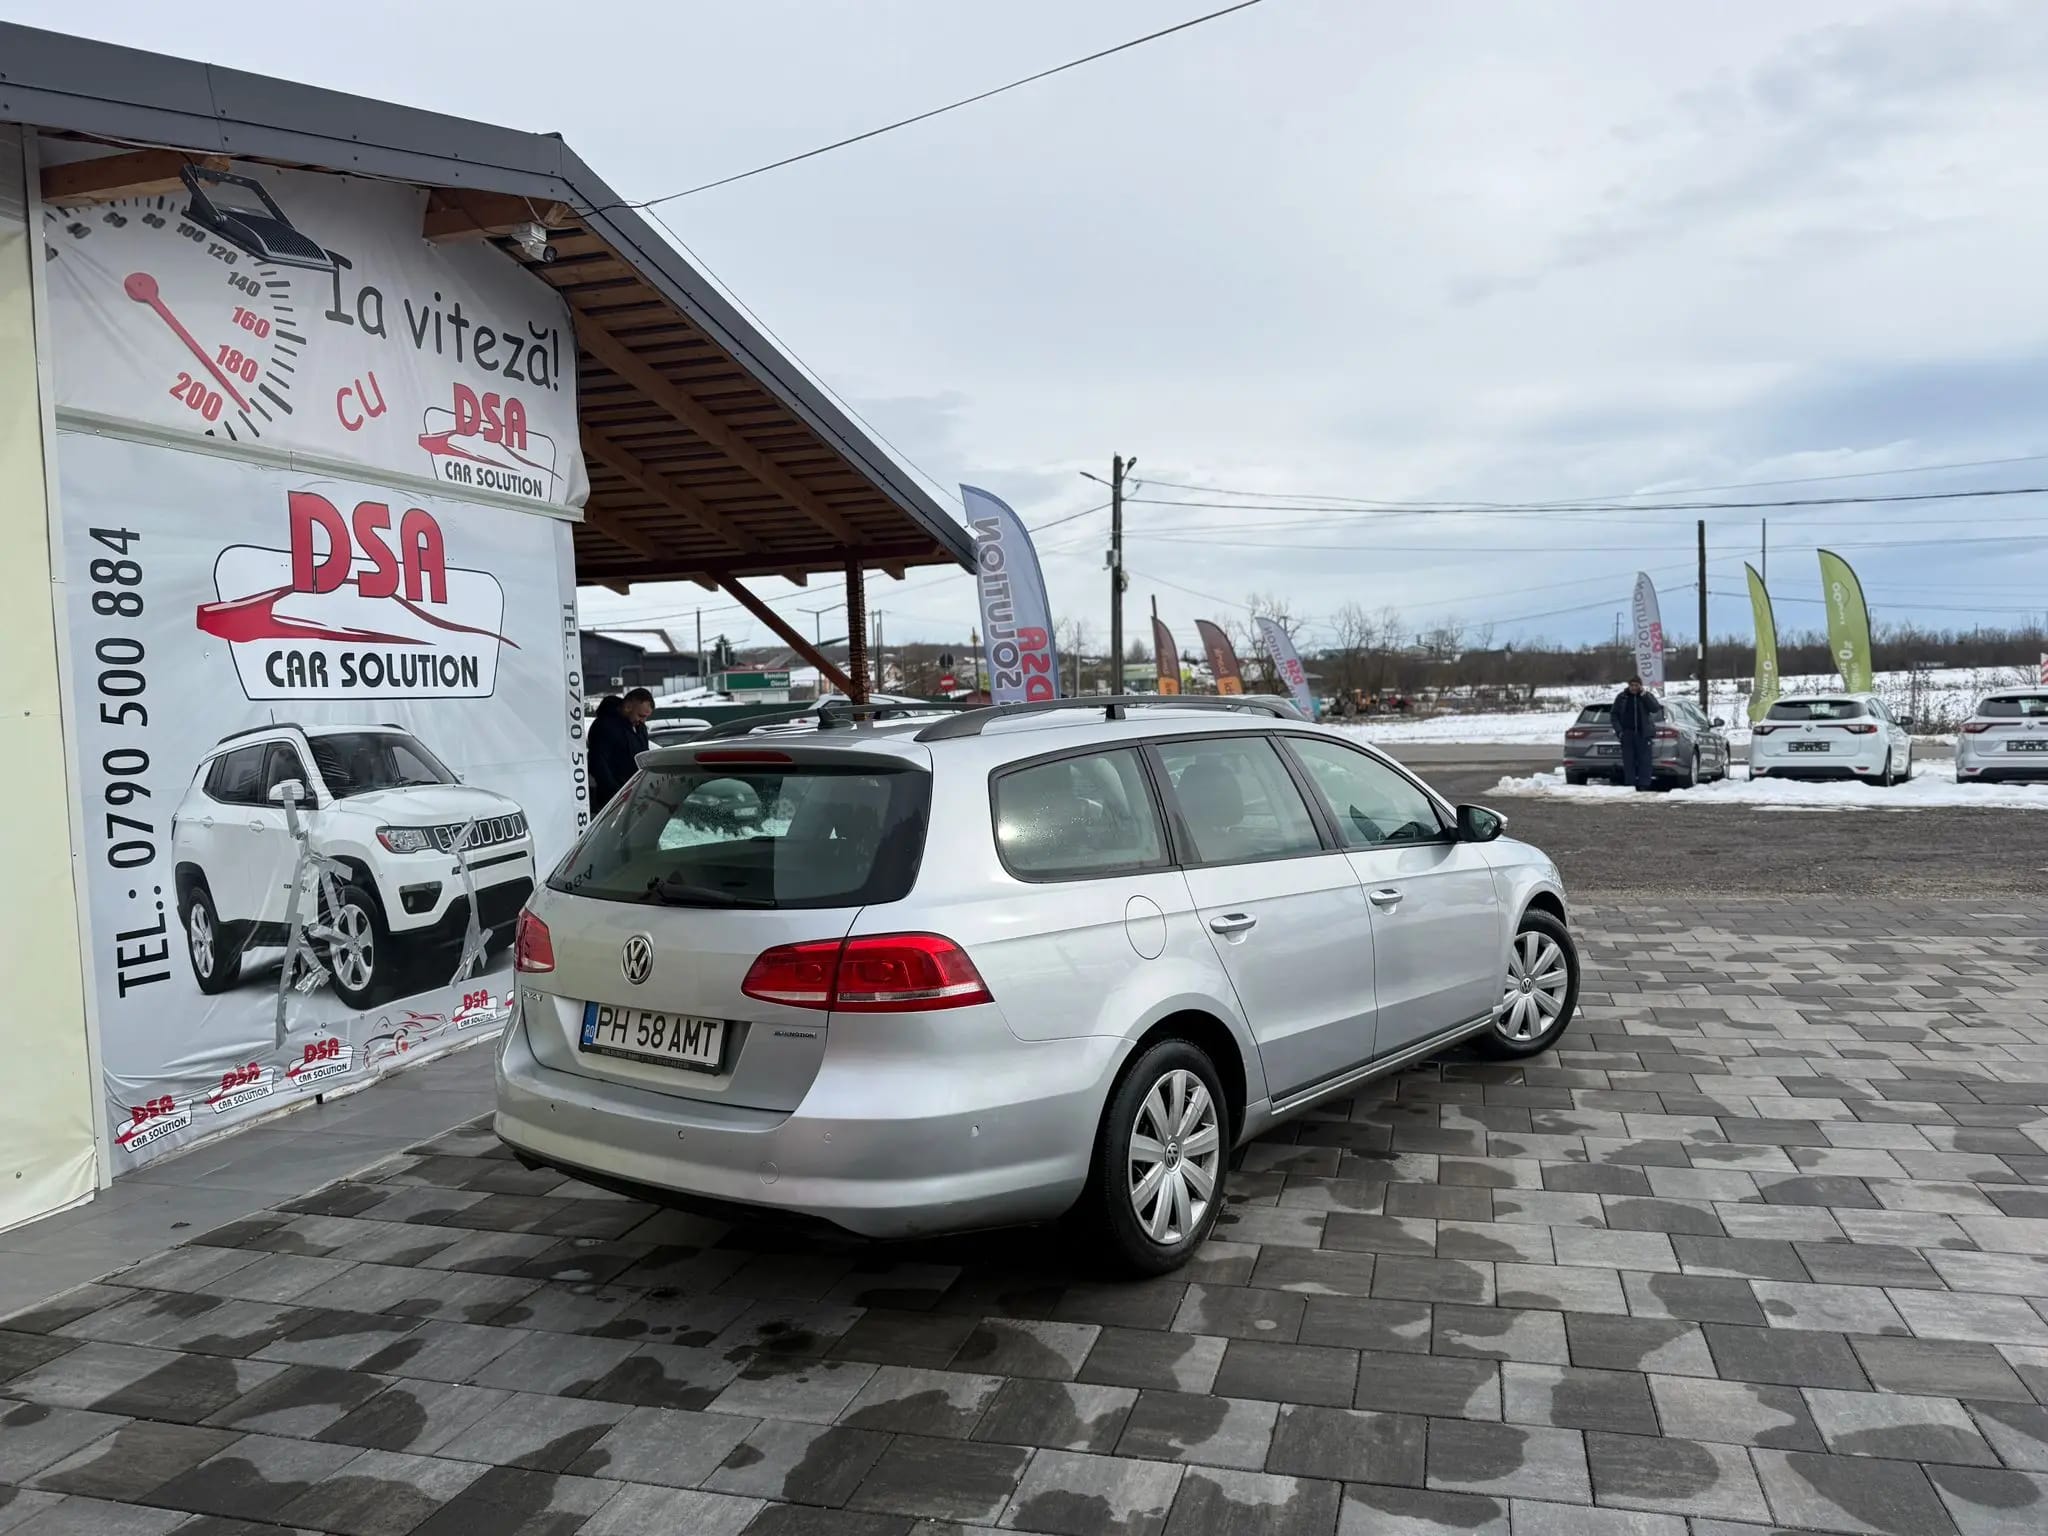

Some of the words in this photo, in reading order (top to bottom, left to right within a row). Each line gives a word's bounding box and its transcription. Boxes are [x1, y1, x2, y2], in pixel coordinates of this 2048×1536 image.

[176, 222, 206, 243] 100
[207, 242, 238, 265] 120
[226, 271, 261, 298] 140
[232, 306, 271, 339] 160
[404, 291, 559, 392] viteză!
[215, 344, 259, 383] 180
[169, 372, 223, 421] 200
[337, 371, 387, 431] cu
[453, 382, 527, 451] DSA
[445, 461, 473, 484] CAR
[476, 468, 542, 498] SOLUTION
[287, 490, 447, 604] DSA
[89, 527, 144, 618] 884
[95, 637, 148, 728] 500
[265, 650, 328, 688] CAR
[340, 652, 478, 688] SOLUTION
[568, 671, 582, 740] 0790
[571, 751, 586, 801] 500
[102, 748, 157, 869] 0790
[116, 884, 171, 999] TEL.:
[463, 989, 488, 1010] DSA
[304, 1037, 339, 1063] DSA
[584, 1024, 595, 1039] RO
[596, 1006, 631, 1044] PH
[636, 1012, 666, 1049] 58
[667, 1017, 717, 1057] AMT
[221, 1062, 261, 1090] DSA
[298, 1073, 312, 1083] CAR
[313, 1063, 348, 1079] SOLUTION
[132, 1095, 175, 1125] DSA
[218, 1099, 233, 1111] CAR
[234, 1086, 270, 1105] SOLUTION
[131, 1134, 148, 1149] CAR
[149, 1116, 187, 1140] SOLUTION
